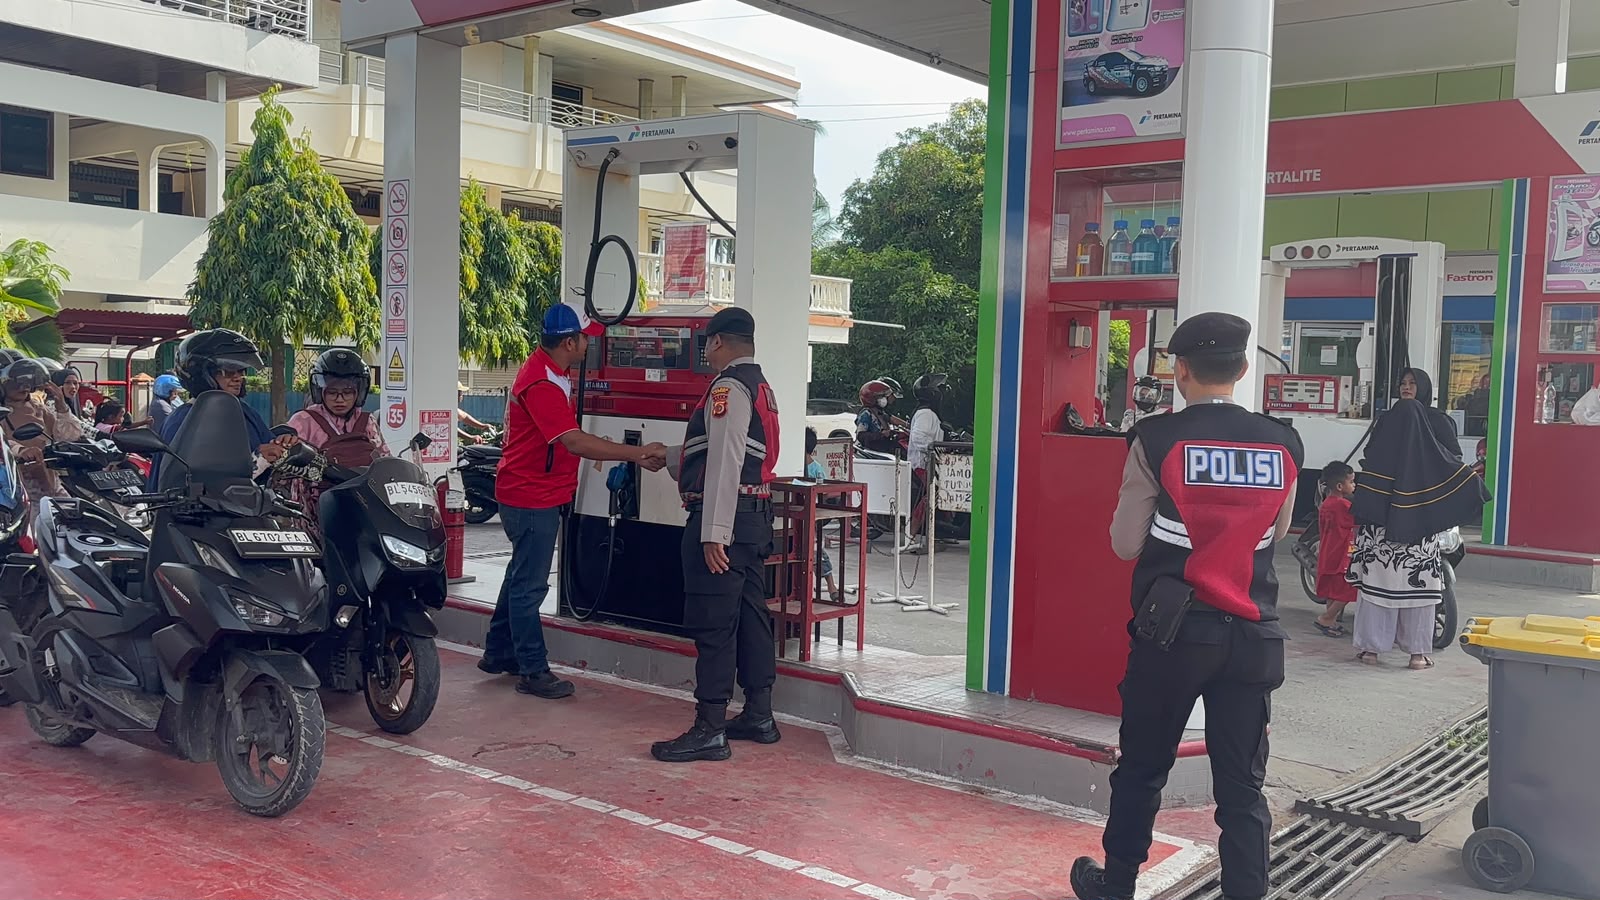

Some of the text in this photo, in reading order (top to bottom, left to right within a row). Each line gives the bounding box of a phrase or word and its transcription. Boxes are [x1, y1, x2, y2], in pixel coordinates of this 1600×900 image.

[1153, 112, 1182, 120] PERTAMINA
[641, 128, 675, 137] PERTAMINA
[1266, 168, 1322, 184] RTALITE
[1446, 273, 1494, 282] Fastron
[830, 467, 837, 479] 4
[1188, 449, 1281, 486] POLISI
[387, 484, 401, 496] BL
[235, 532, 310, 543] BL 6702 FAJ
[172, 584, 191, 605] HONDA
